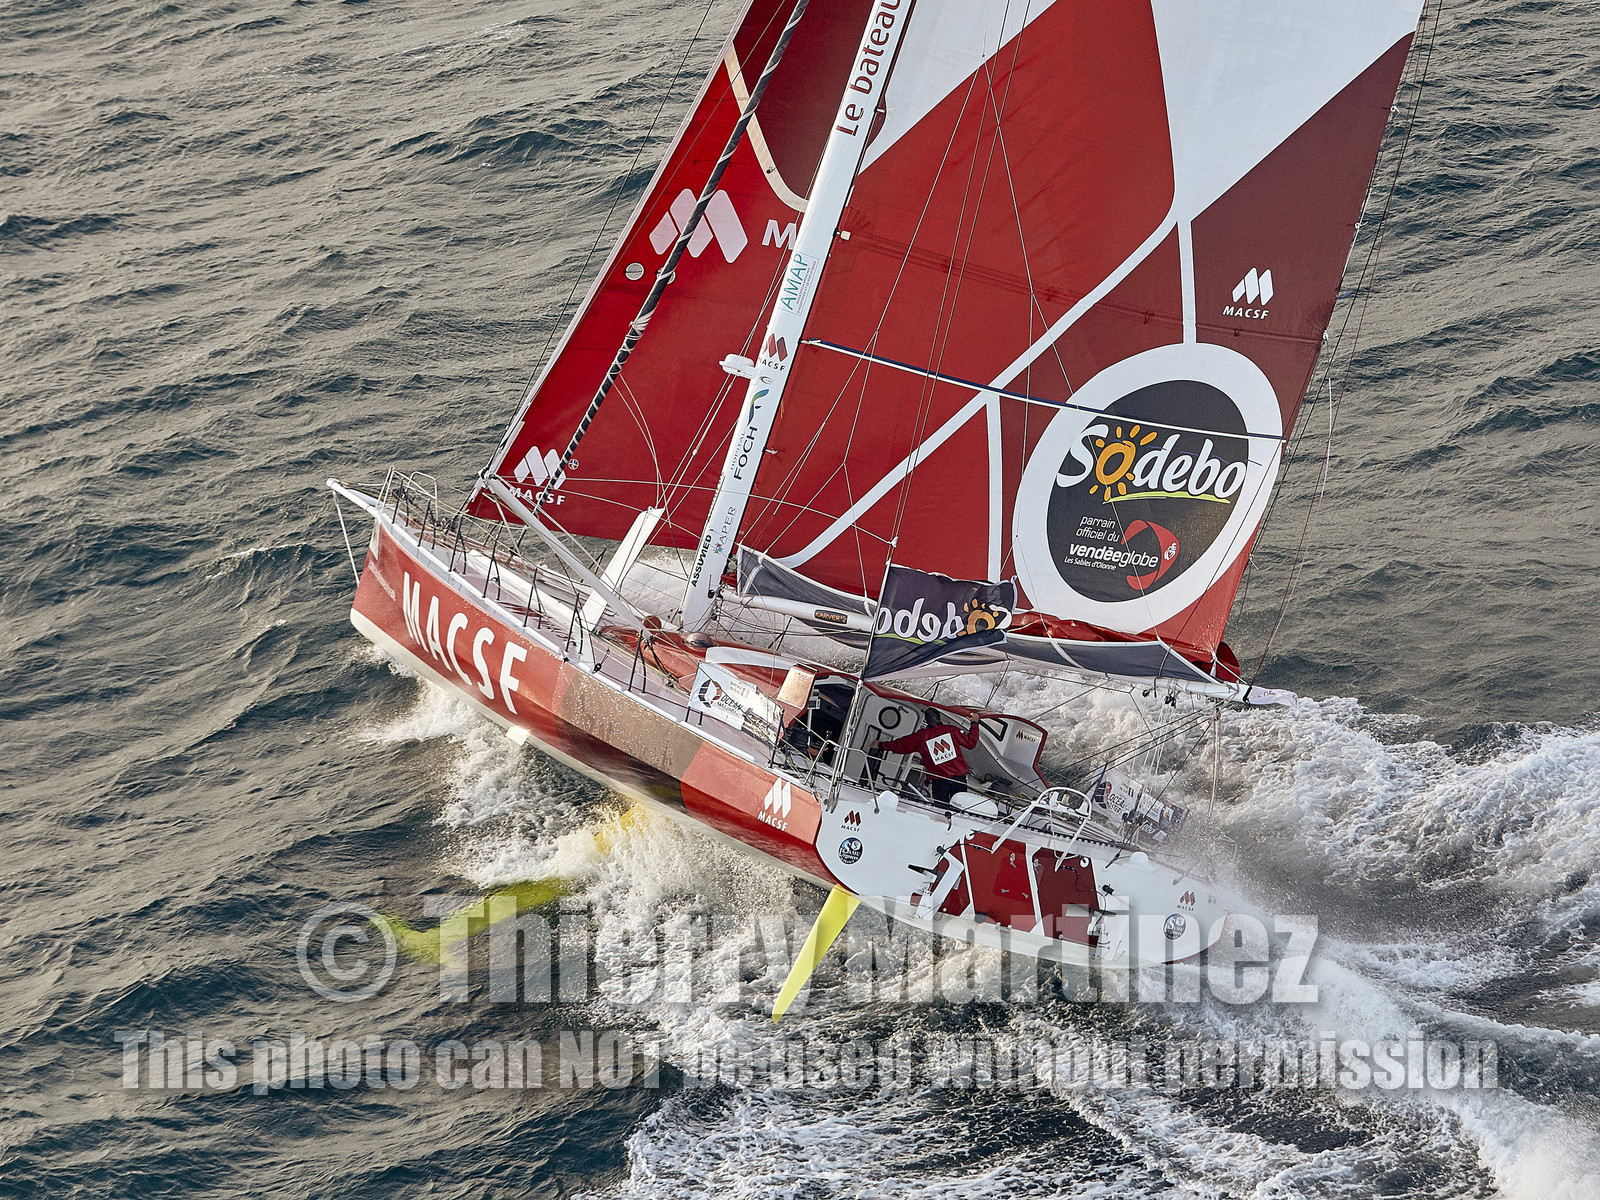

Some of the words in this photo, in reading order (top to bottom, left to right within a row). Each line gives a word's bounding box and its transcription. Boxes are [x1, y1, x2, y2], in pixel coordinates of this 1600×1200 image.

[836, 107, 864, 137] Le
[780, 253, 808, 310] AMAP
[1222, 305, 1270, 320] MACSF
[733, 426, 758, 480] FOCH
[1056, 424, 1247, 501] Sodebo
[719, 506, 738, 545] APER
[1080, 516, 1116, 529] parrain
[1075, 527, 1108, 540] officiel
[1107, 531, 1120, 543] du
[1064, 556, 1074, 564] Les
[1073, 557, 1091, 567] Sables
[1091, 560, 1117, 571] d'Olonne
[402, 571, 528, 715] MACSF
[935, 751, 954, 762] MACSF
[757, 810, 788, 832] MACSF
[840, 824, 861, 833] MACSF
